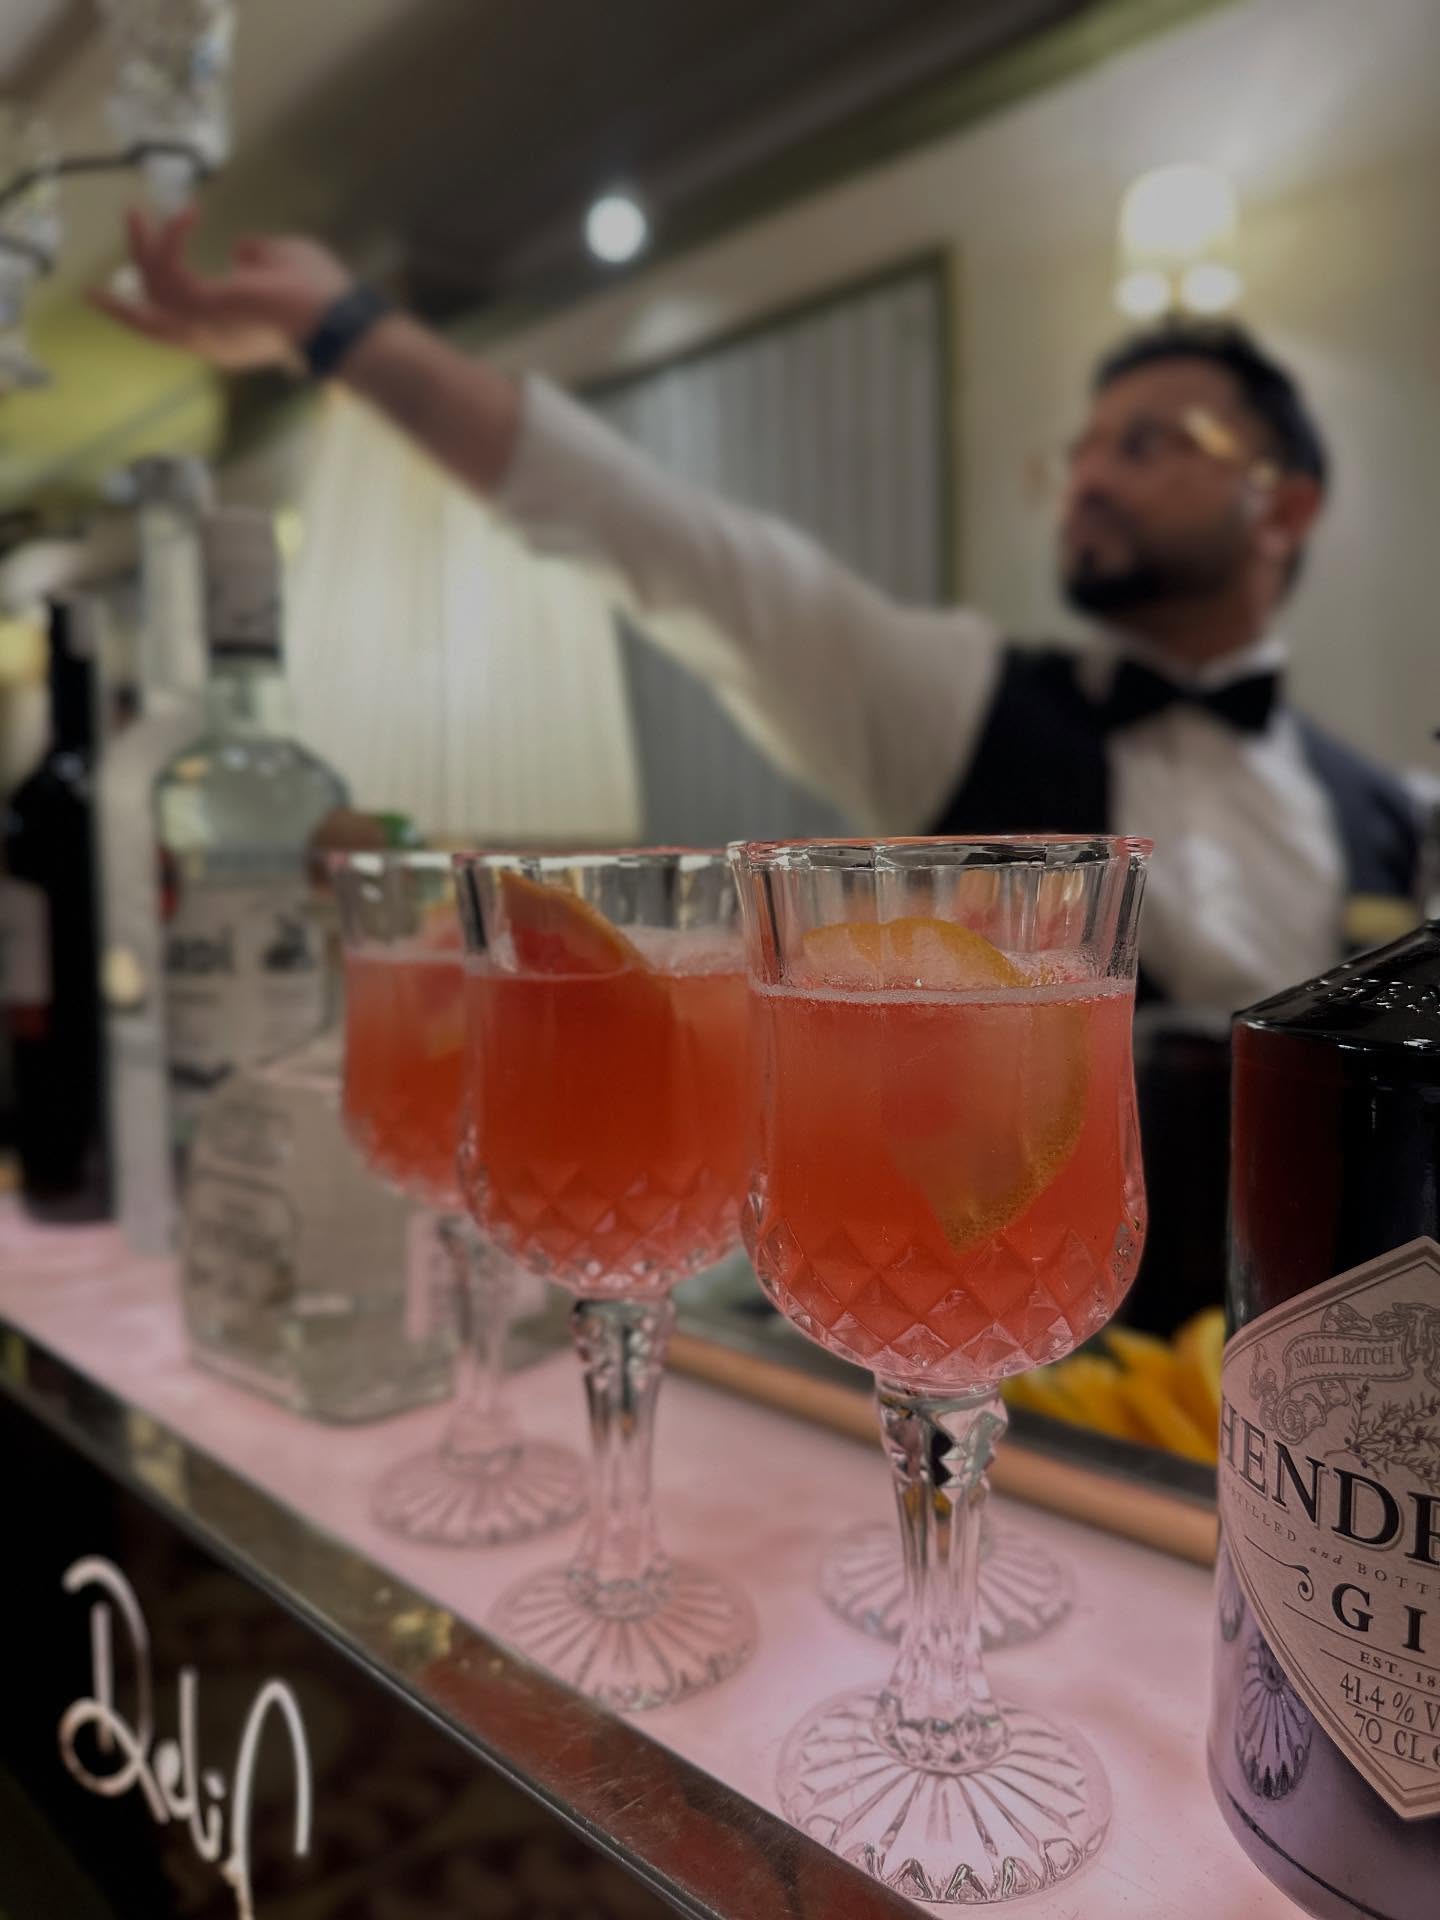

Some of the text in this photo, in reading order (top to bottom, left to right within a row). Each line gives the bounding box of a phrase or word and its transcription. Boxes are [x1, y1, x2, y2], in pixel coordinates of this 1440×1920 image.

[1294, 1346, 1393, 1368] SMALL BATCH
[1357, 1562, 1440, 1600] BOTT
[1360, 1651, 1440, 1688] EST. 18
[1339, 1672, 1385, 1712] 41.4
[1354, 1711, 1383, 1745] 70
[1393, 1729, 1425, 1763] CL
